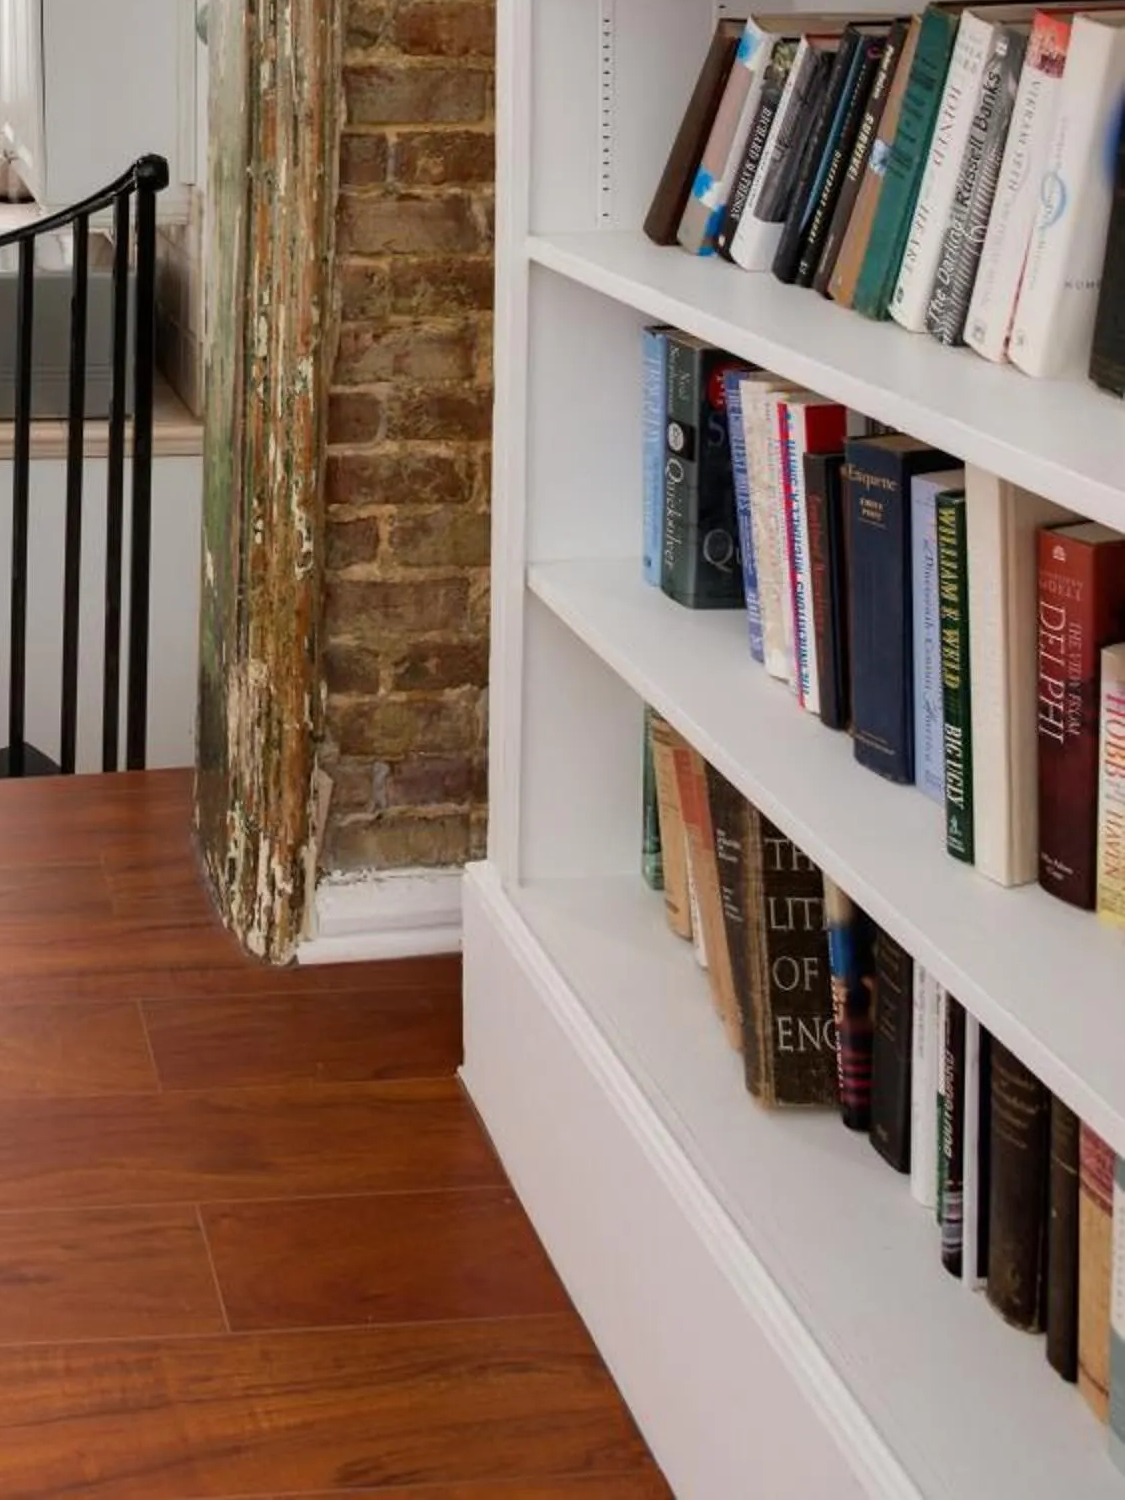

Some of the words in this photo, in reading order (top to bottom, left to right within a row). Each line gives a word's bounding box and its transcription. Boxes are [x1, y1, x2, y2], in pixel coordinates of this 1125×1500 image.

[955, 133, 983, 209] Russell
[978, 70, 1002, 133] Banks
[927, 292, 947, 326] The
[664, 457, 685, 571] Quicksilver
[937, 506, 960, 601] WILLIAM
[943, 630, 961, 690] WELD
[1038, 599, 1067, 745] DELPHI
[944, 722, 962, 759] BIG
[946, 759, 965, 811] UGLY
[772, 955, 819, 992] OF
